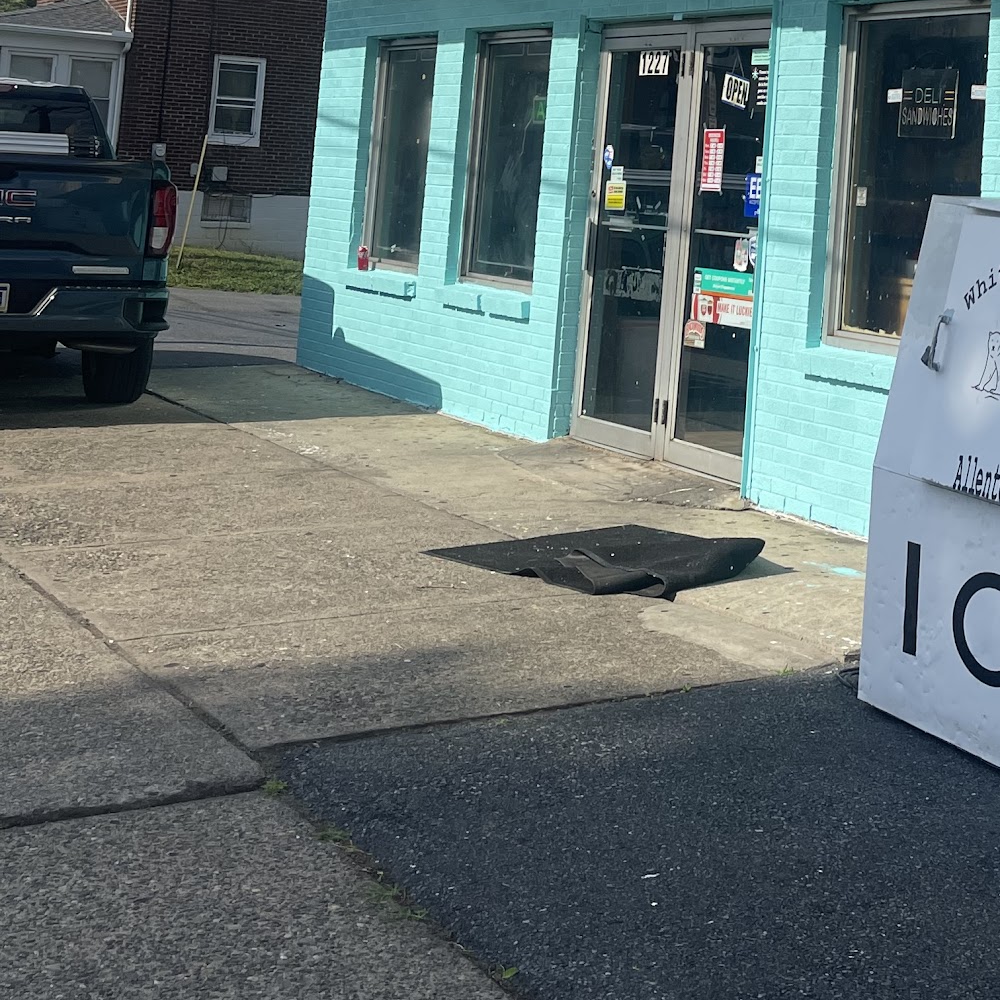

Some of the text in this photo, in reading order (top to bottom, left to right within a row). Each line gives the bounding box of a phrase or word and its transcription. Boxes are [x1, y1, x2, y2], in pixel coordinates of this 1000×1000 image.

[642, 51, 669, 74] 1227
[726, 77, 749, 105] OPEN
[915, 88, 942, 104] DELI
[717, 302, 729, 313] MAKE
[731, 304, 735, 314] IT
